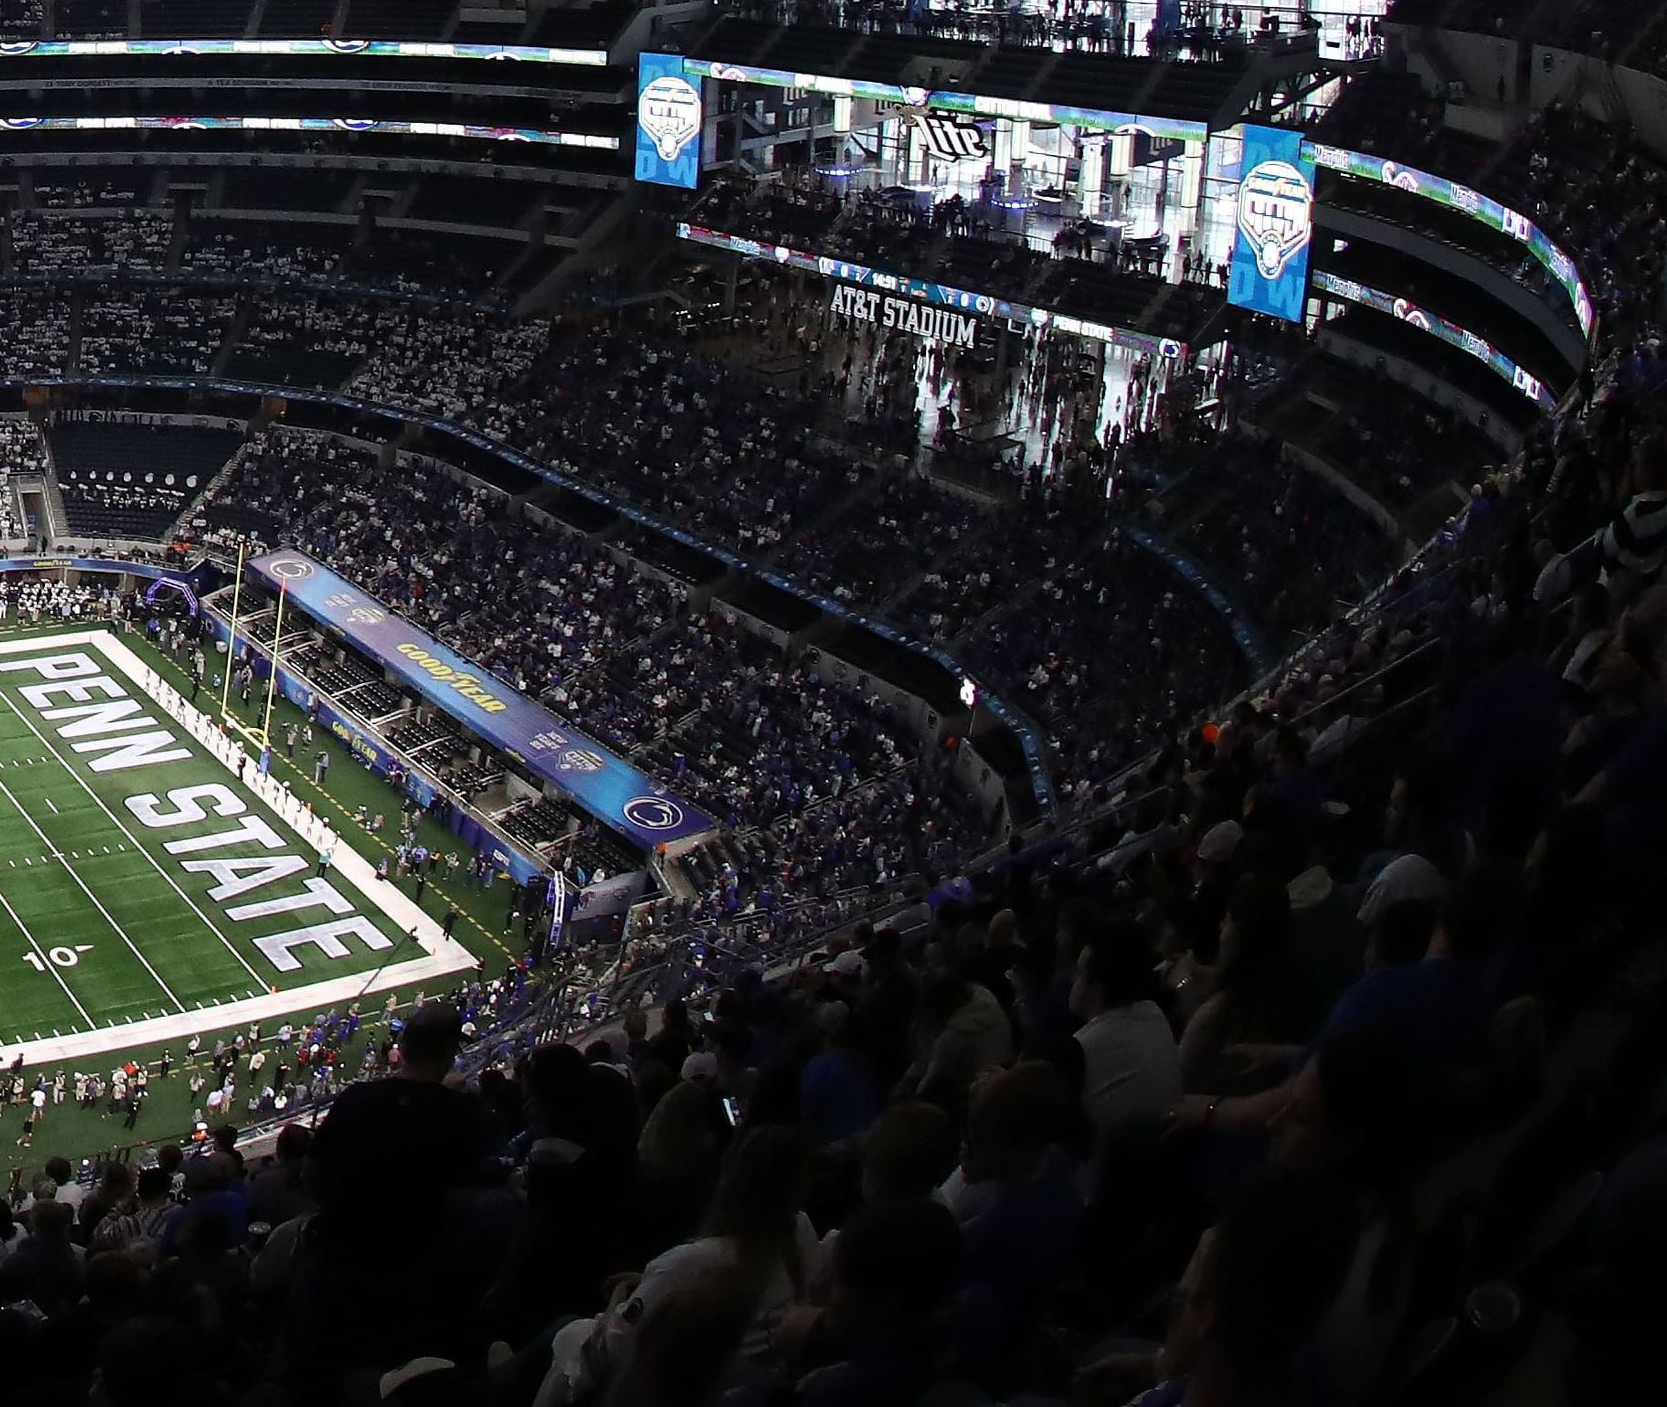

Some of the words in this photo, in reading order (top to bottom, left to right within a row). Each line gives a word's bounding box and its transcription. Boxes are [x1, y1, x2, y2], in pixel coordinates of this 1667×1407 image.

[916, 115, 985, 160] Lite
[830, 284, 880, 322] AT&T
[882, 296, 976, 349] STADIUM
[397, 643, 508, 713] GOODYEAR
[123, 782, 395, 974] STATE
[22, 946, 78, 971] 10
